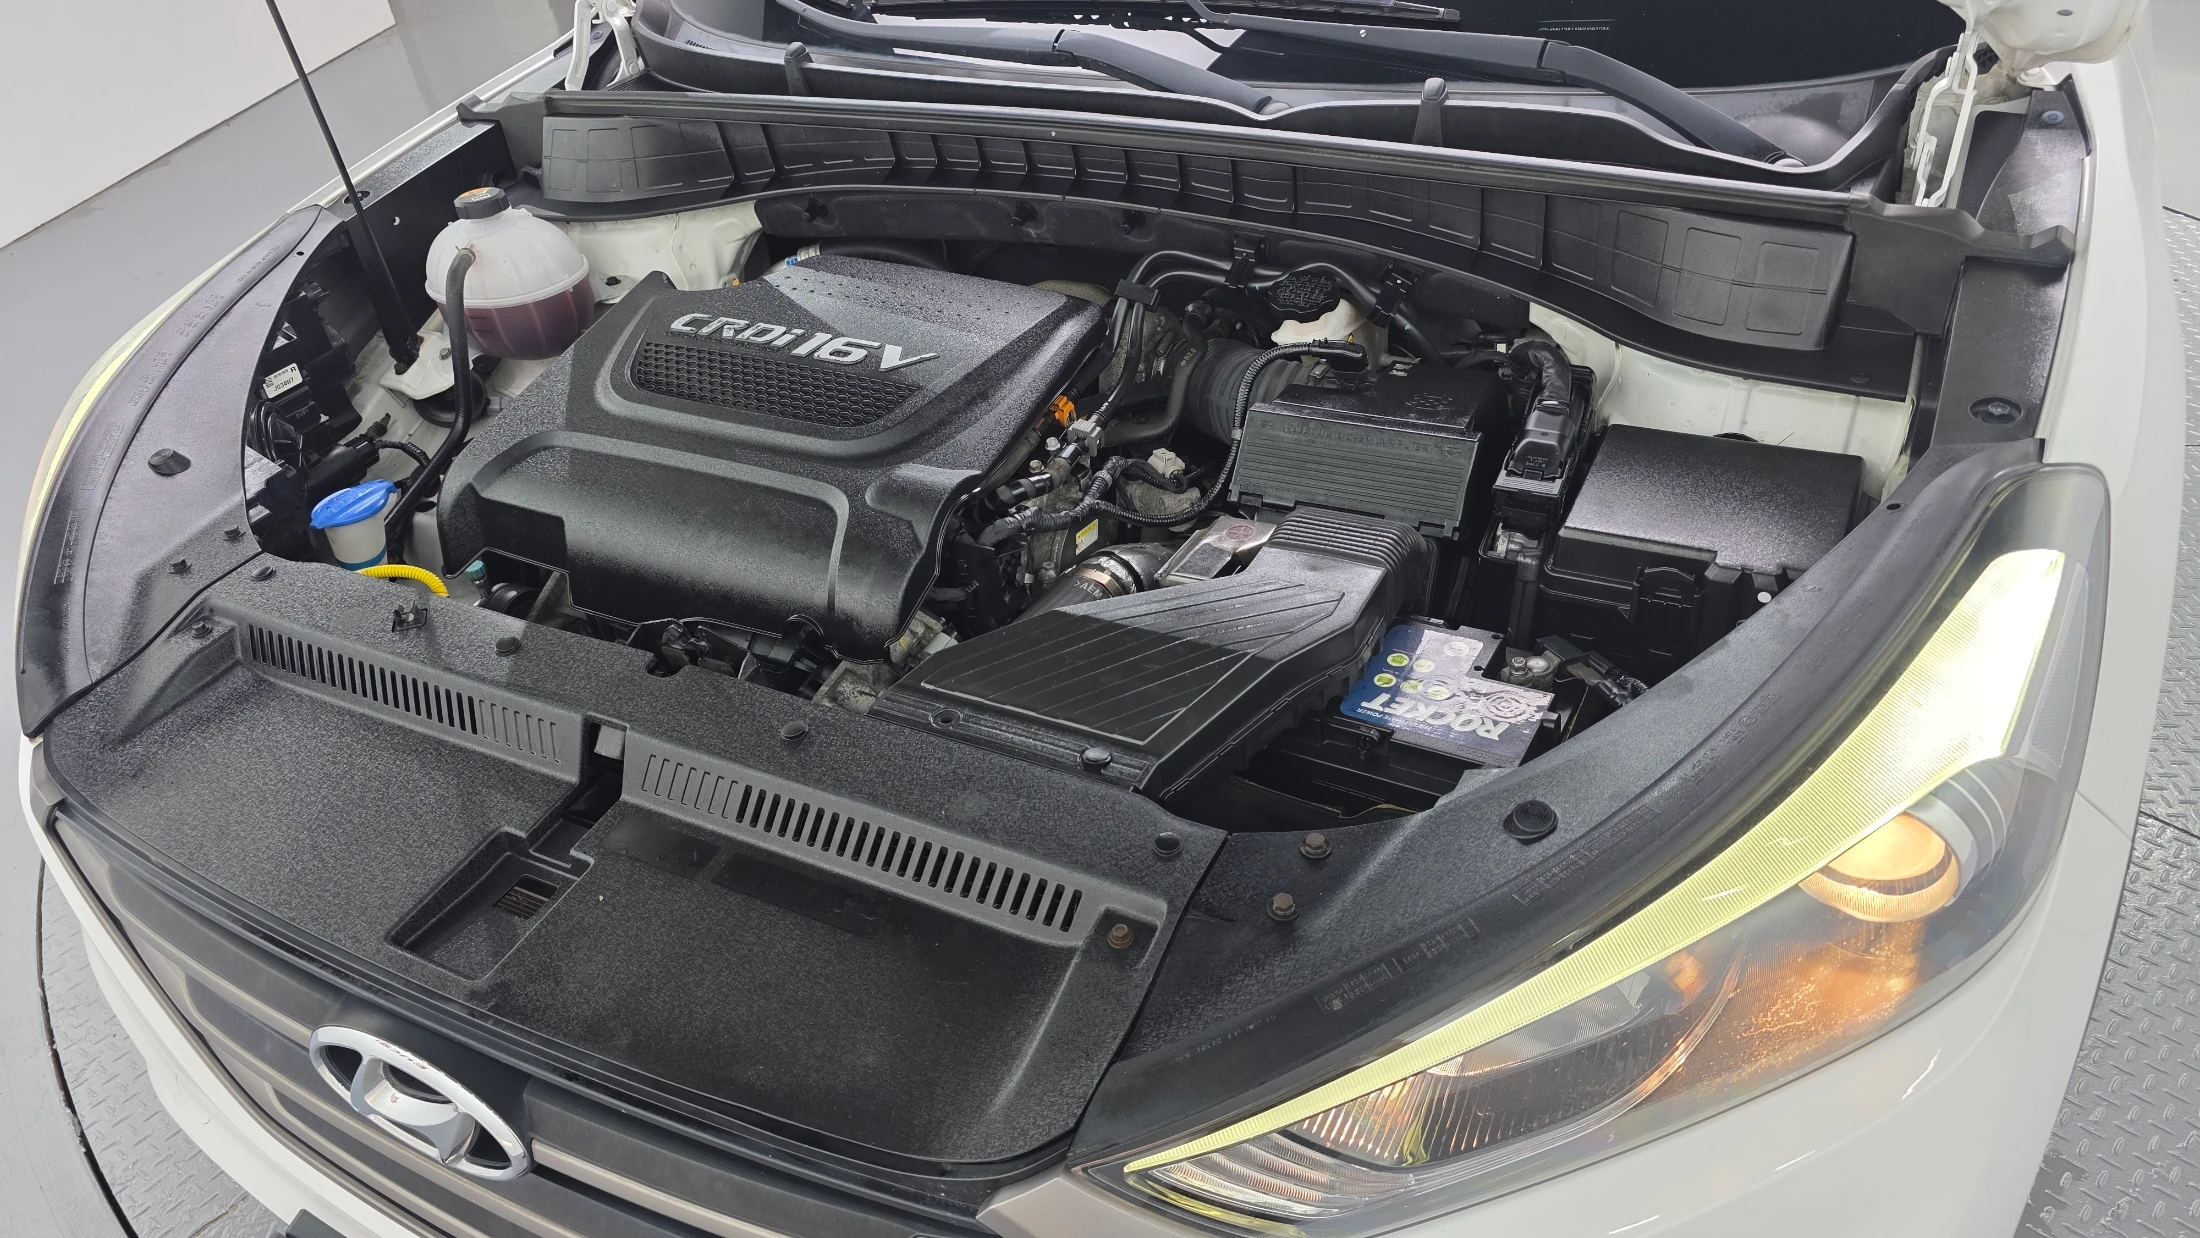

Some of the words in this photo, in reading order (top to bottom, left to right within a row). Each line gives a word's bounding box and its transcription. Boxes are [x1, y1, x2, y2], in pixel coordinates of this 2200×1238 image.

[669, 313, 805, 347] CRDi
[790, 332, 940, 372] 16V
[1356, 707, 1384, 719] POWER
[1361, 692, 1511, 740] ROCKET
